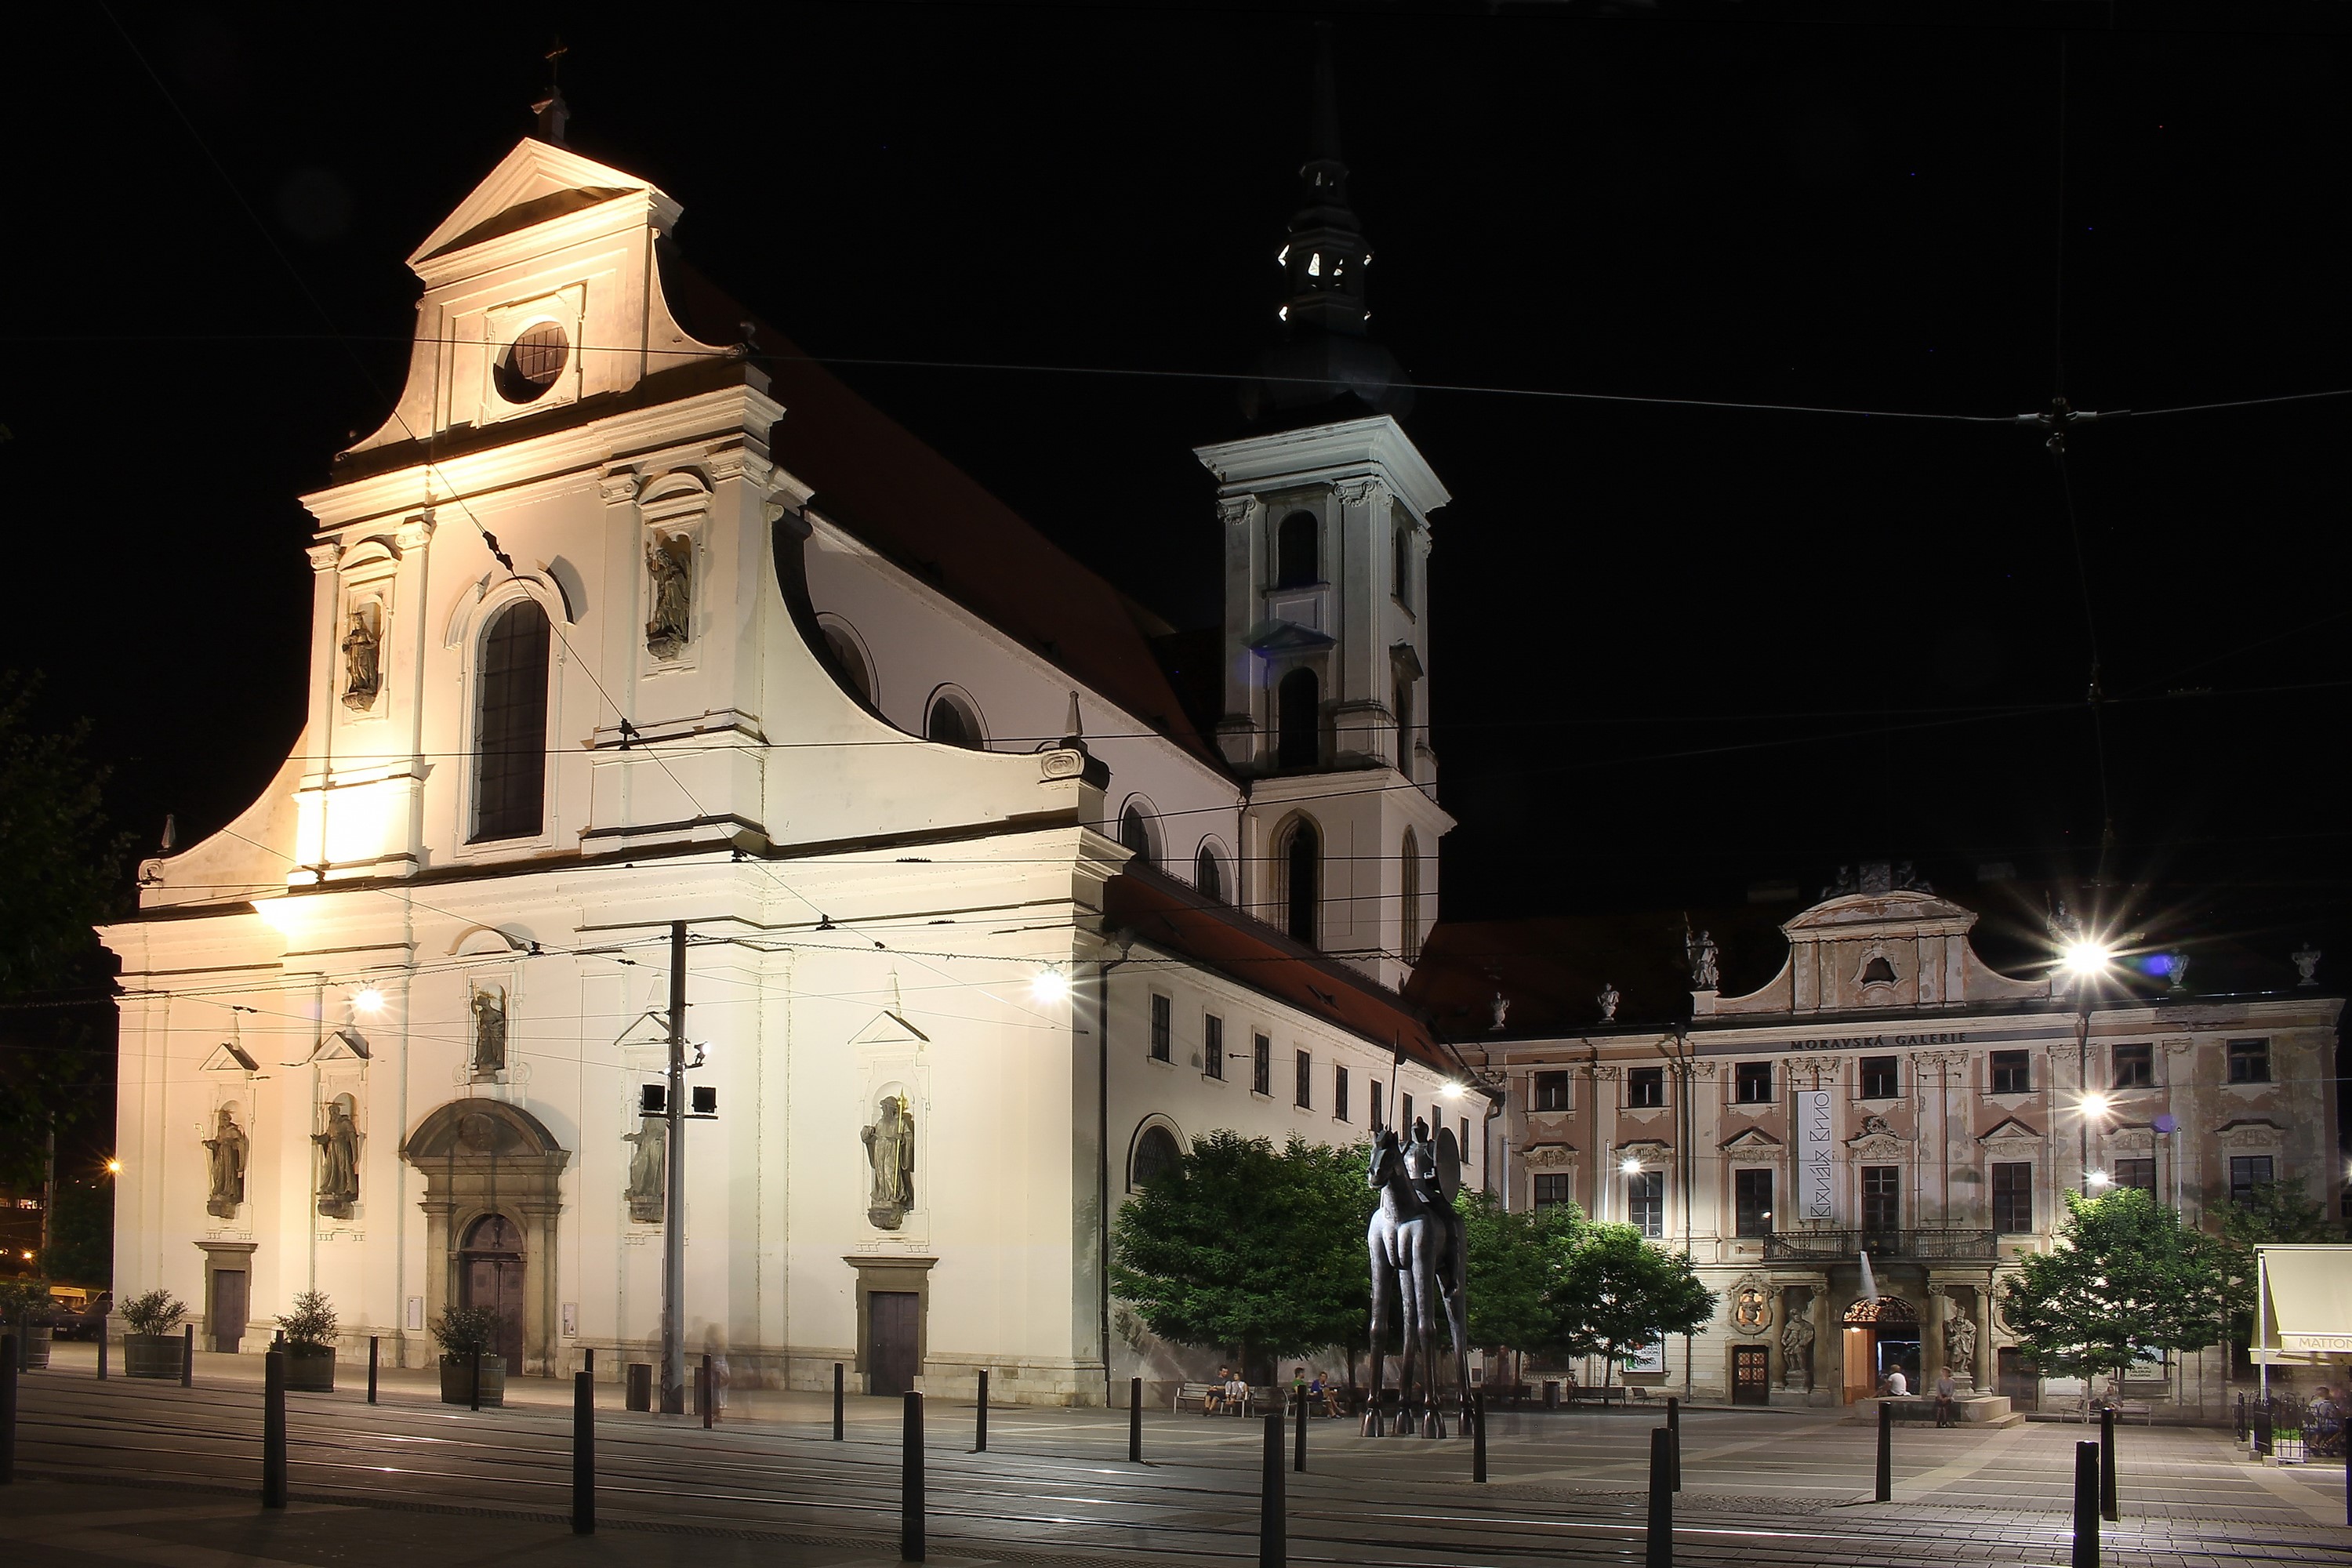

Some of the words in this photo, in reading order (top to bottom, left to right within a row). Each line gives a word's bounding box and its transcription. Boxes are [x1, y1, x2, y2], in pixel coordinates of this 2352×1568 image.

[1791, 1035, 1883, 1050] MORAVSKÁ
[1896, 1033, 1966, 1045] GALERIE
[1809, 1093, 1830, 1142] Brno
